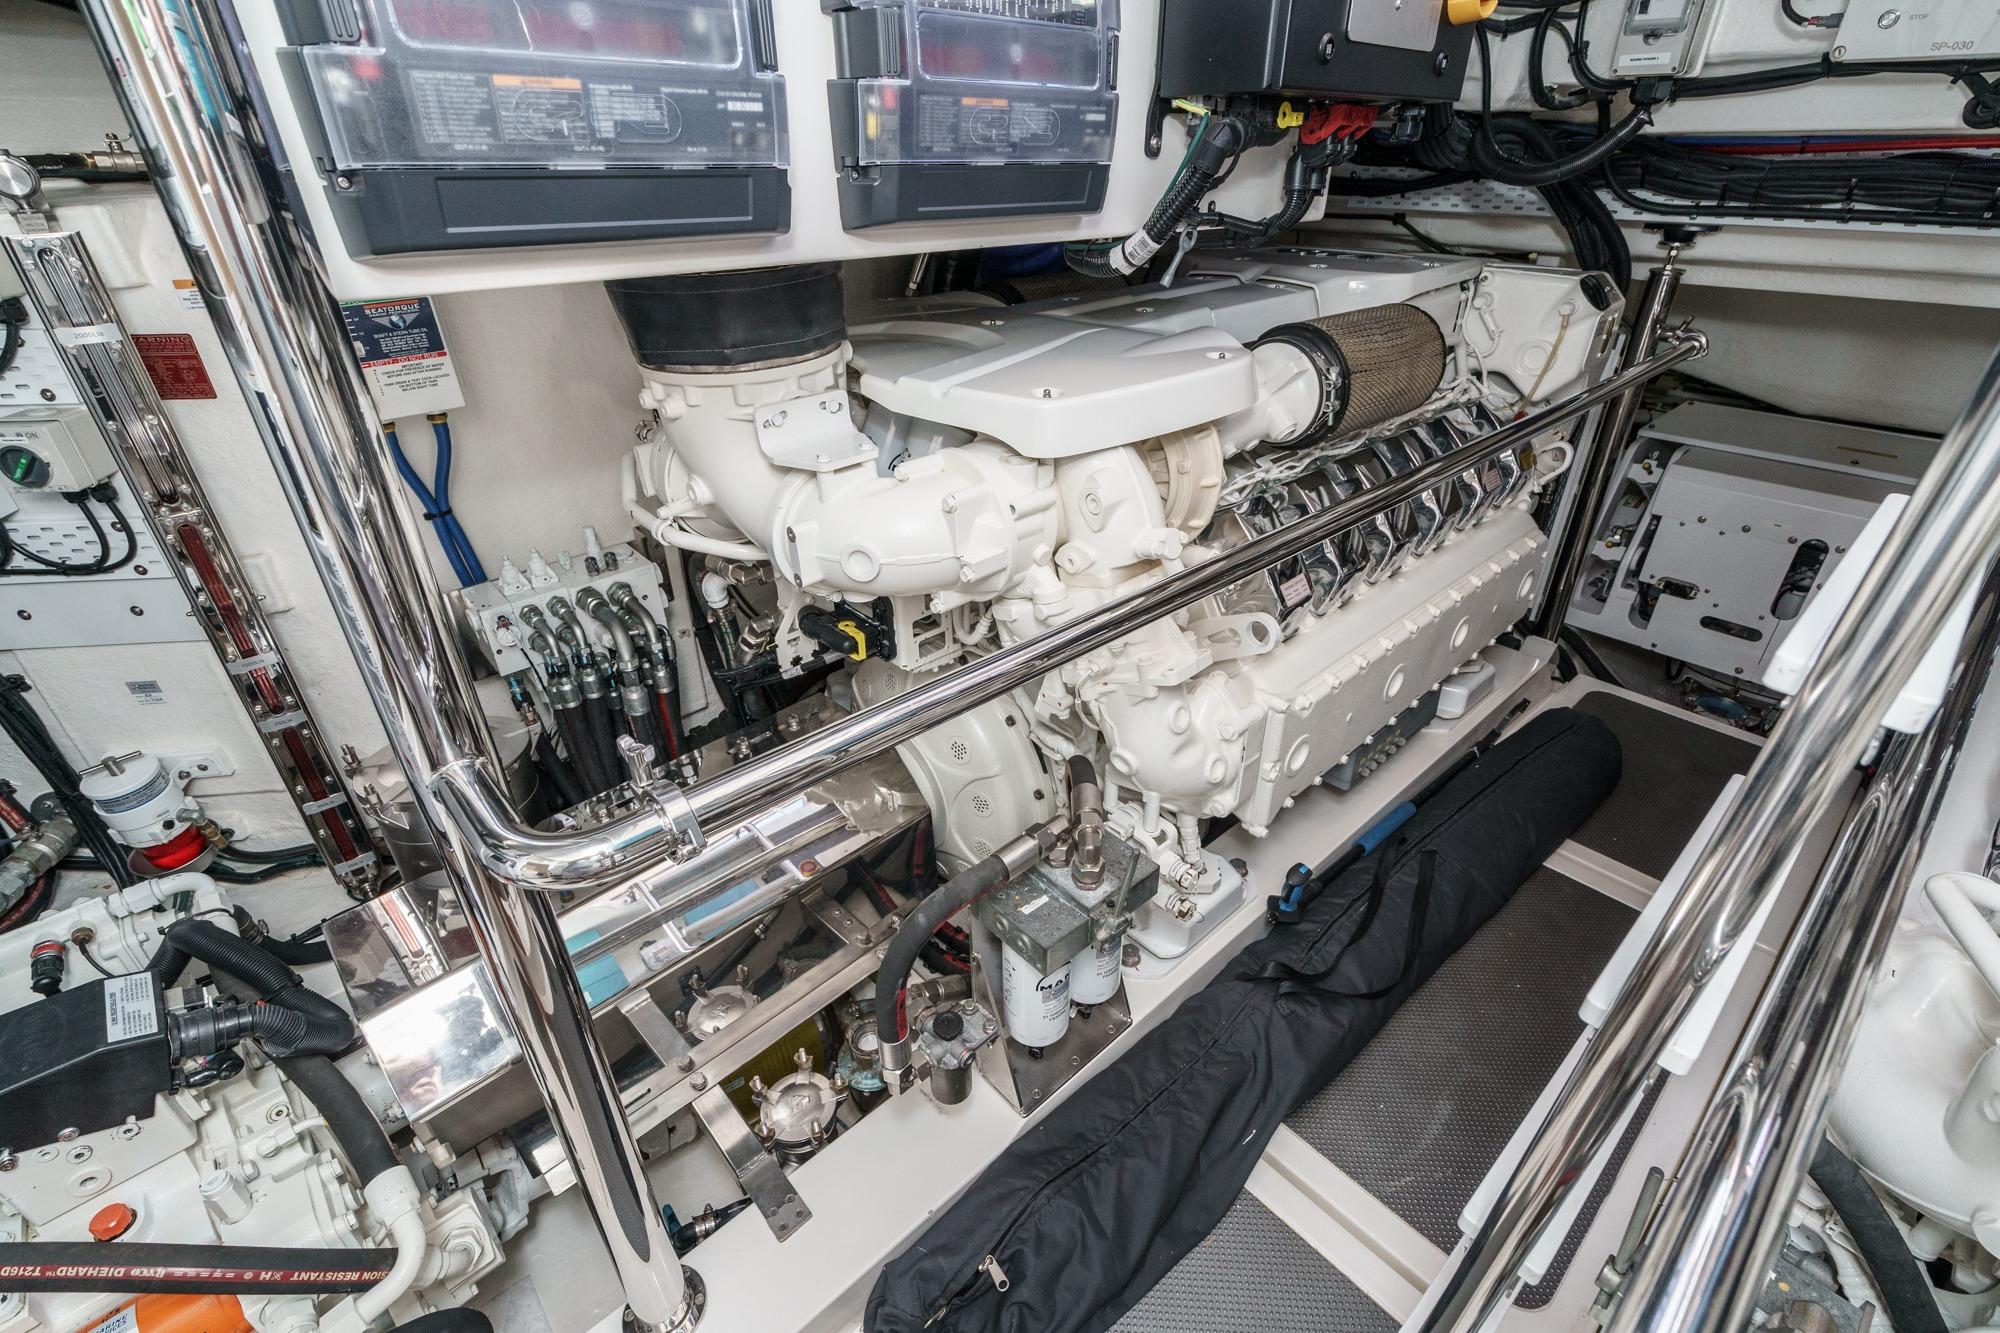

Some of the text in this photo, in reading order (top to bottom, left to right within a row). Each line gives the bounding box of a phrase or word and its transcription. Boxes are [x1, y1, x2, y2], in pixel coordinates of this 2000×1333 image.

[1930, 41, 1974, 51] SP-030
[365, 304, 420, 314] SEATORQUE
[0, 1266, 41, 1277] T216D
[290, 1271, 361, 1280] RESISTANT
[362, 1269, 390, 1280] SION
